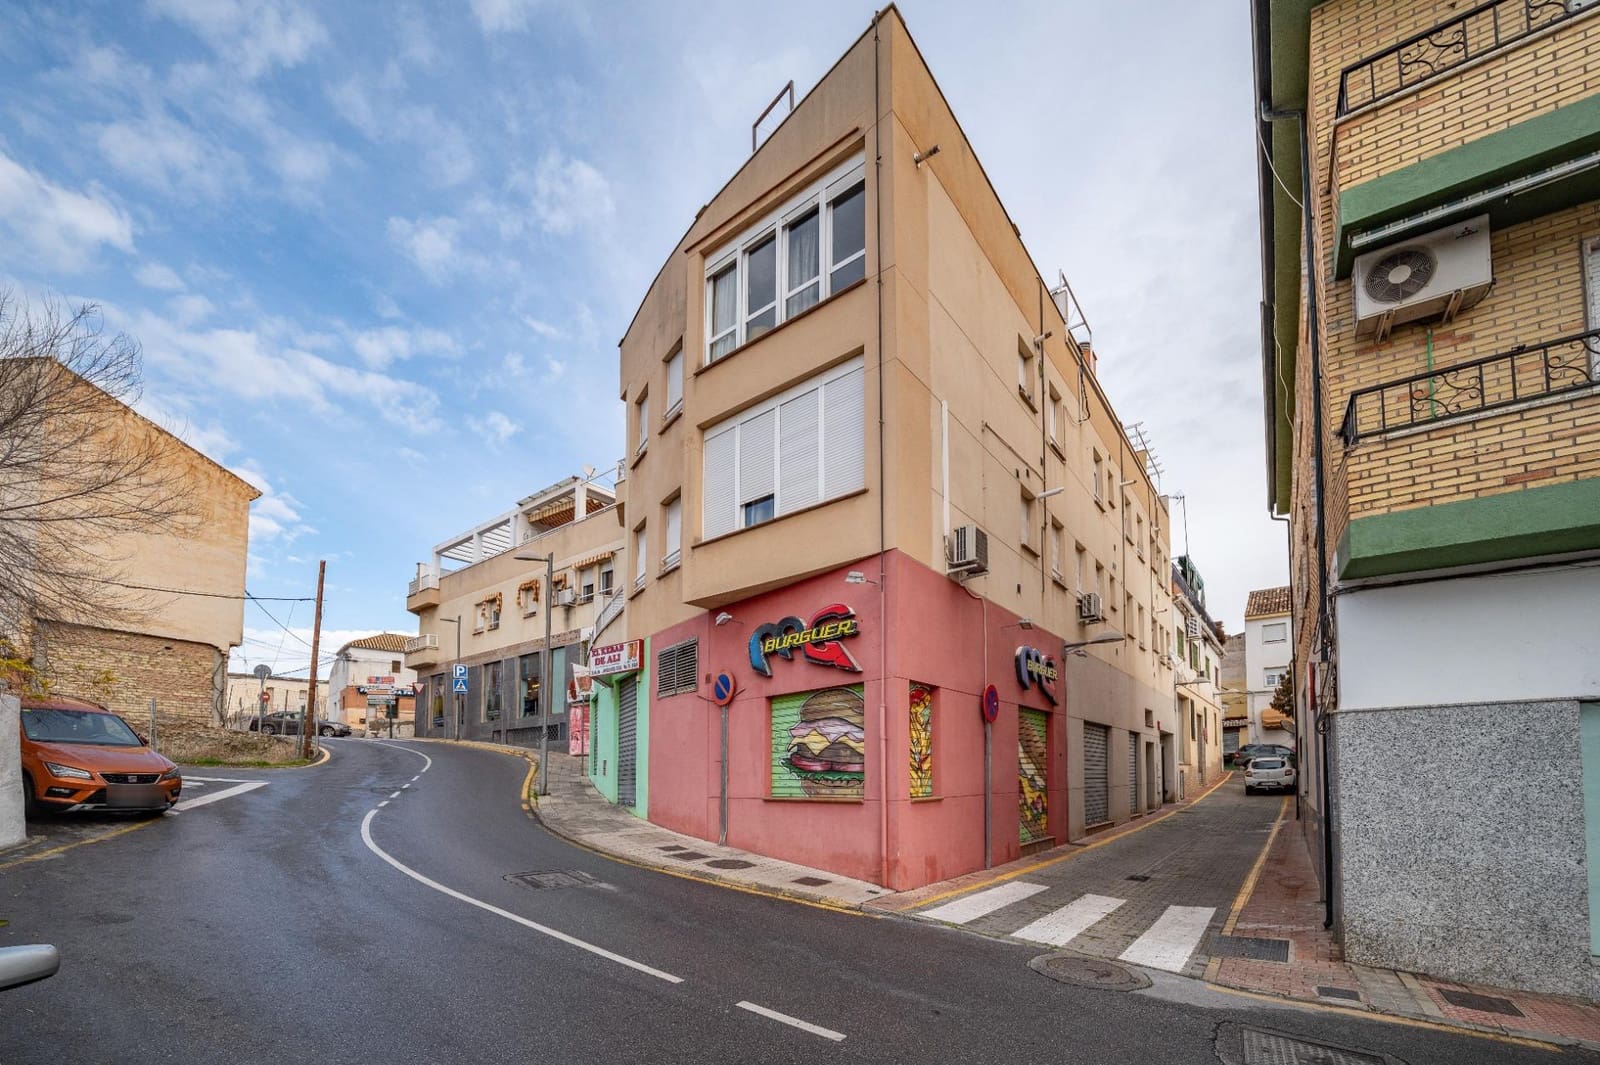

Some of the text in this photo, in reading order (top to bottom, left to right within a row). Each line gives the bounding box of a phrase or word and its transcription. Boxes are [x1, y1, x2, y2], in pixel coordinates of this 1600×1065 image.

[765, 619, 853, 652] BURGUER
[592, 643, 624, 657] EL KEBAB
[595, 656, 606, 666] DE
[607, 653, 621, 664] ALI
[456, 666, 466, 677] P
[1027, 659, 1057, 679] BURGUER
